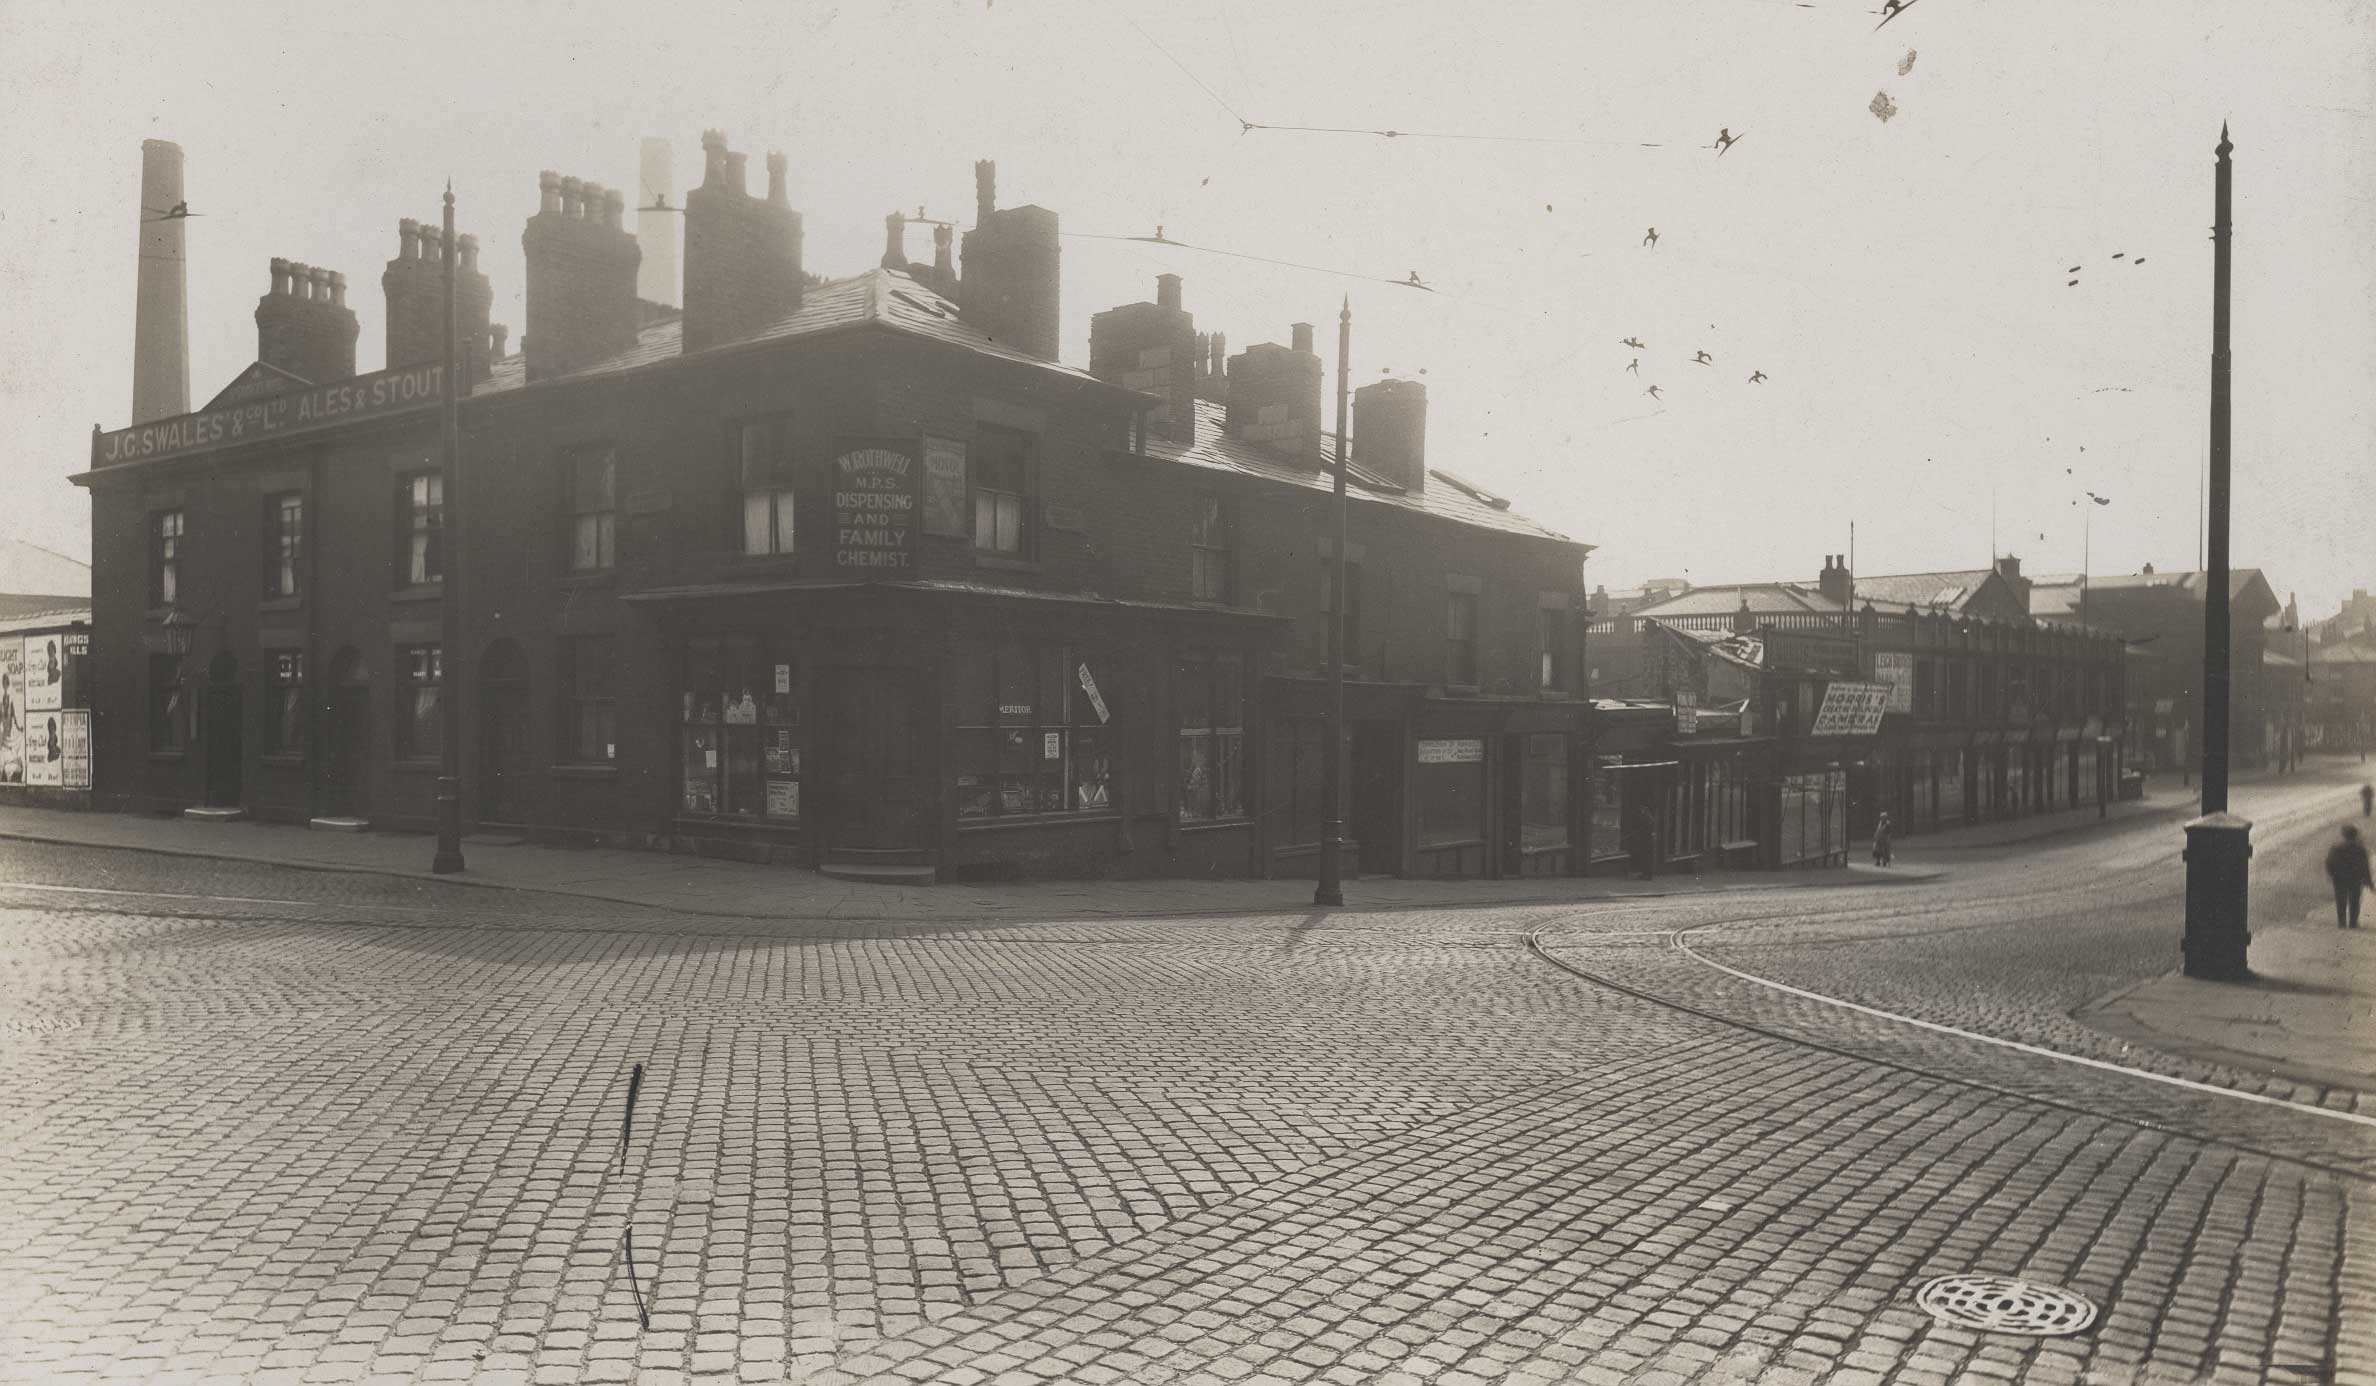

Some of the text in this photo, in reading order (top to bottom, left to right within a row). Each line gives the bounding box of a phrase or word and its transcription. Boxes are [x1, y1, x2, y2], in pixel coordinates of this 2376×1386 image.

[297, 386, 352, 421] ALES
[354, 388, 367, 409] &
[373, 366, 444, 407] STOUT
[836, 491, 912, 510] DISPENSING
[854, 512, 889, 526] AND
[840, 529, 905, 546] FAMILY
